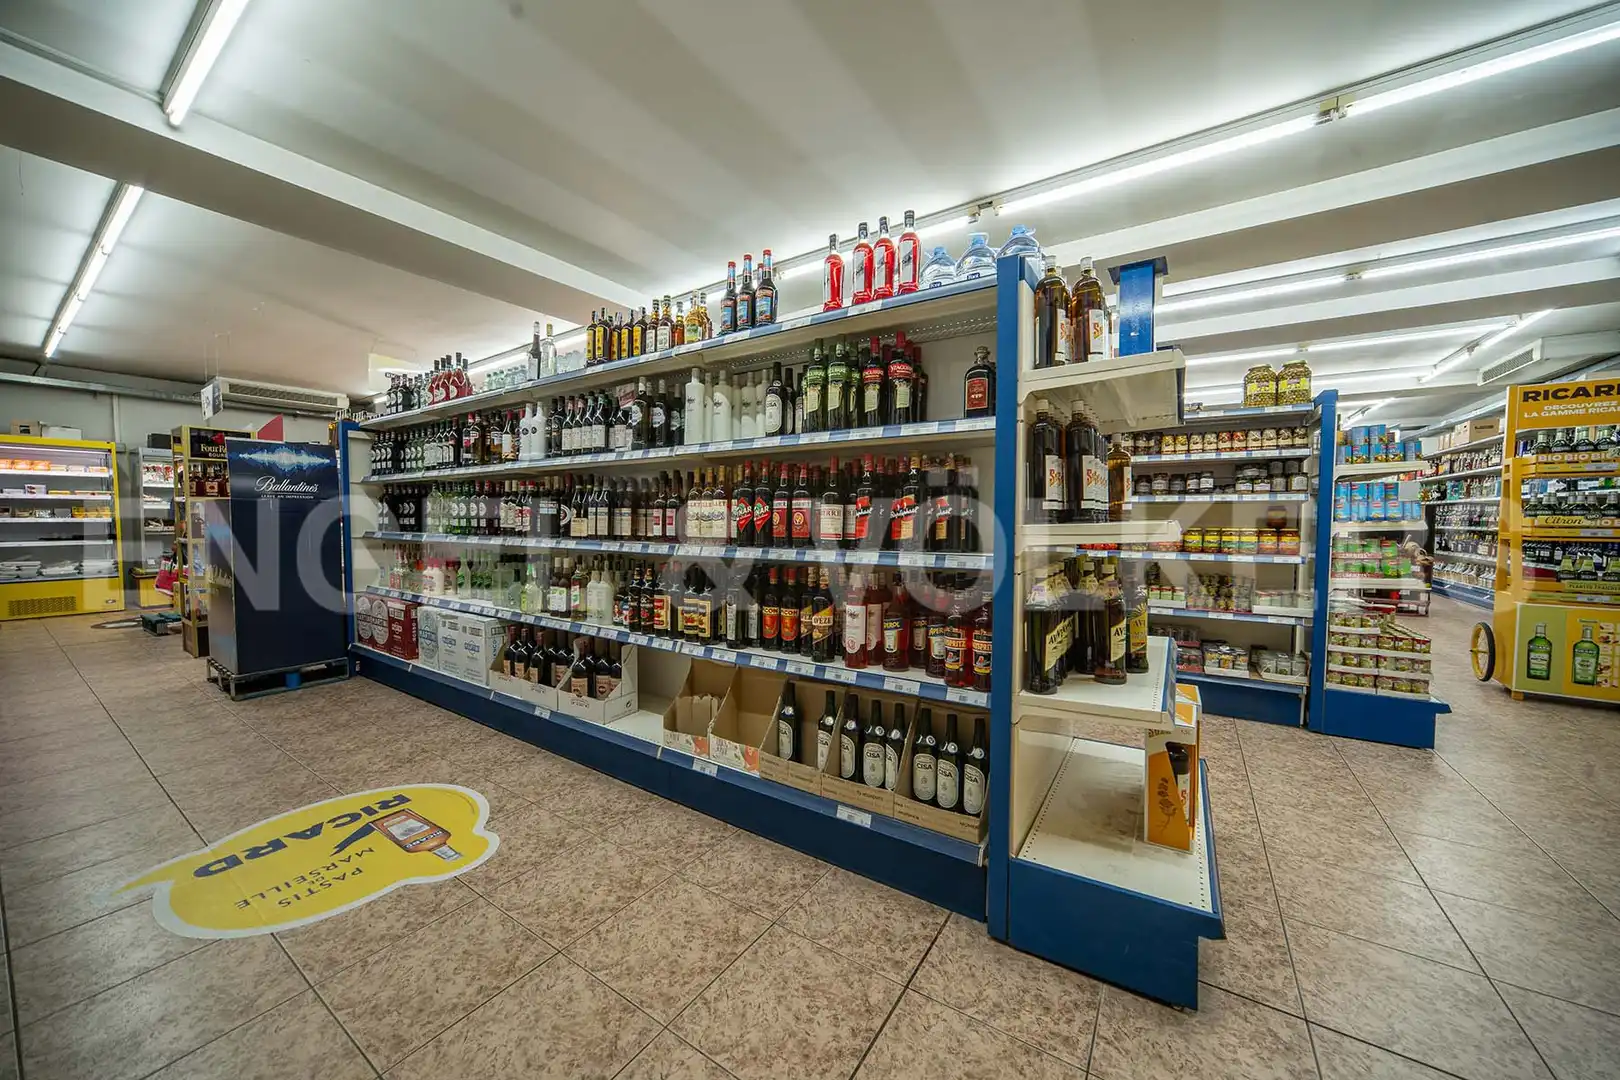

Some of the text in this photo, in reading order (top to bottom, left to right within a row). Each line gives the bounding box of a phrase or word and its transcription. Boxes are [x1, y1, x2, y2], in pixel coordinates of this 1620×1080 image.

[1541, 408, 1586, 417] GAMME
[1537, 453, 1561, 462] BIO
[1565, 452, 1589, 461] BIO
[254, 475, 319, 492] Ballantine's
[1545, 516, 1584, 524] Citron
[916, 762, 933, 770] CISA
[193, 794, 412, 878] RICARD
[405, 830, 444, 850] RICARD
[233, 846, 375, 911] MARSEILLE
[277, 866, 364, 909] PASTIS
